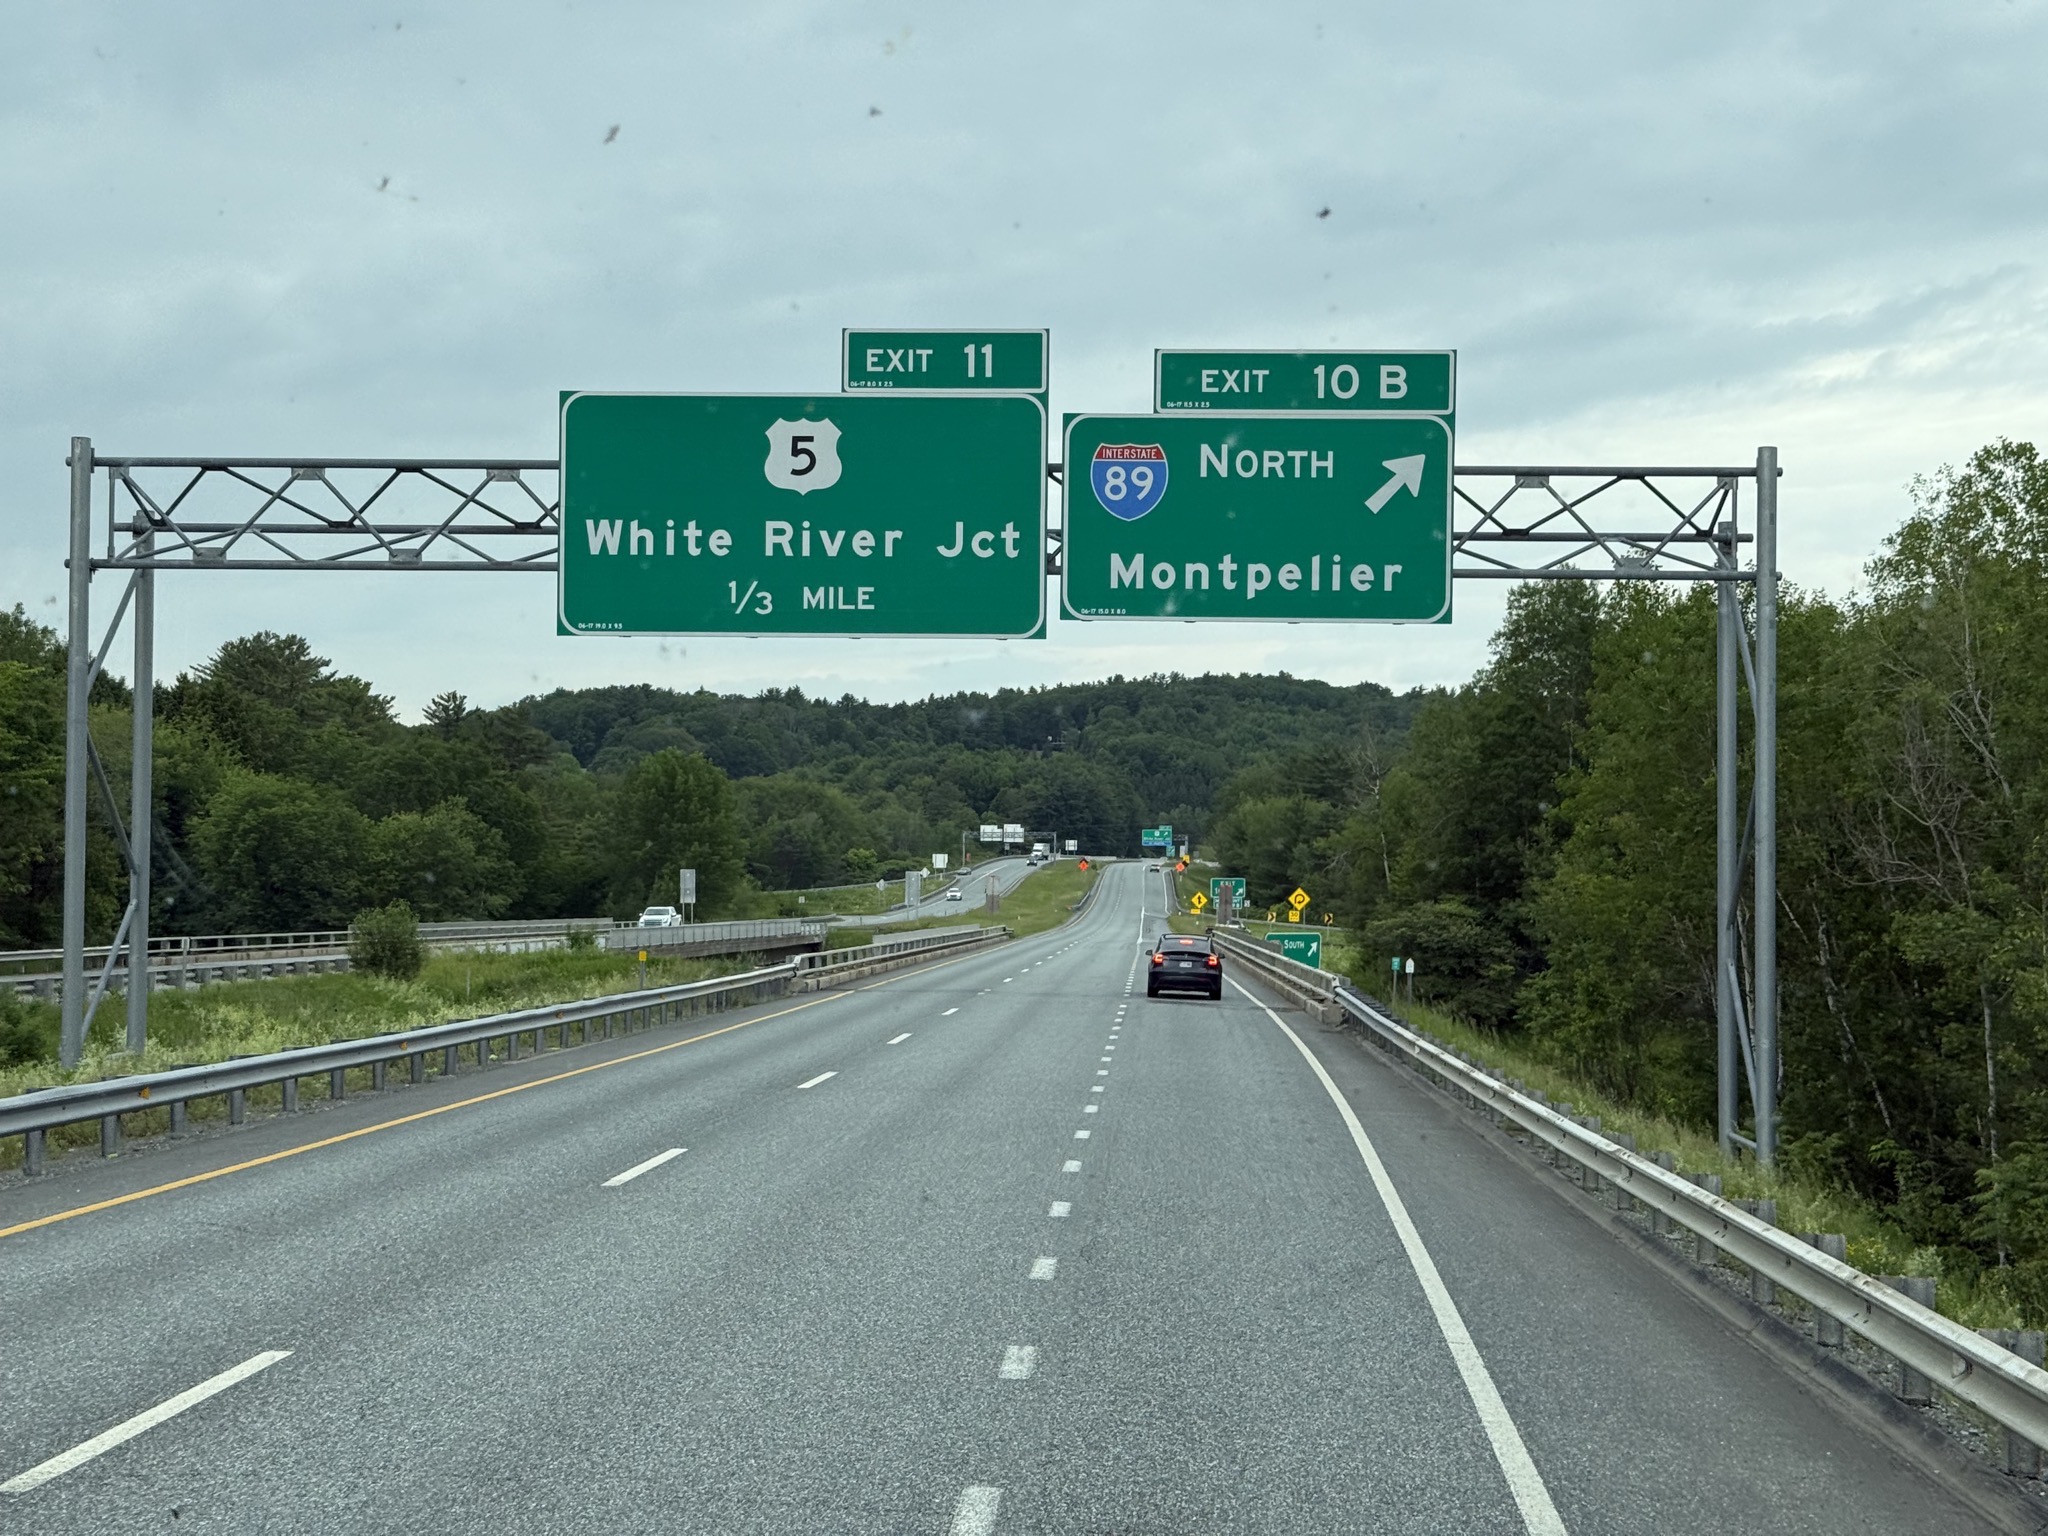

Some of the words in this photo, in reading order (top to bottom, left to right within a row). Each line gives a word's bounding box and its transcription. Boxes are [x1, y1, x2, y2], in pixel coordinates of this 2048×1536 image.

[866, 348, 933, 372] EXIT
[963, 343, 993, 378] 11
[1201, 369, 1270, 393] EXIT
[1313, 364, 1360, 399] 10
[1379, 364, 1408, 399] B
[790, 435, 817, 477] 5
[1101, 447, 1158, 460] INTERSTATE
[1103, 465, 1155, 501] 89
[585, 519, 733, 557] White
[765, 519, 903, 558] River
[936, 521, 1020, 559] Jct
[1110, 553, 1403, 600] Montpelier
[728, 581, 773, 615] 1/3
[803, 586, 875, 610] MILE
